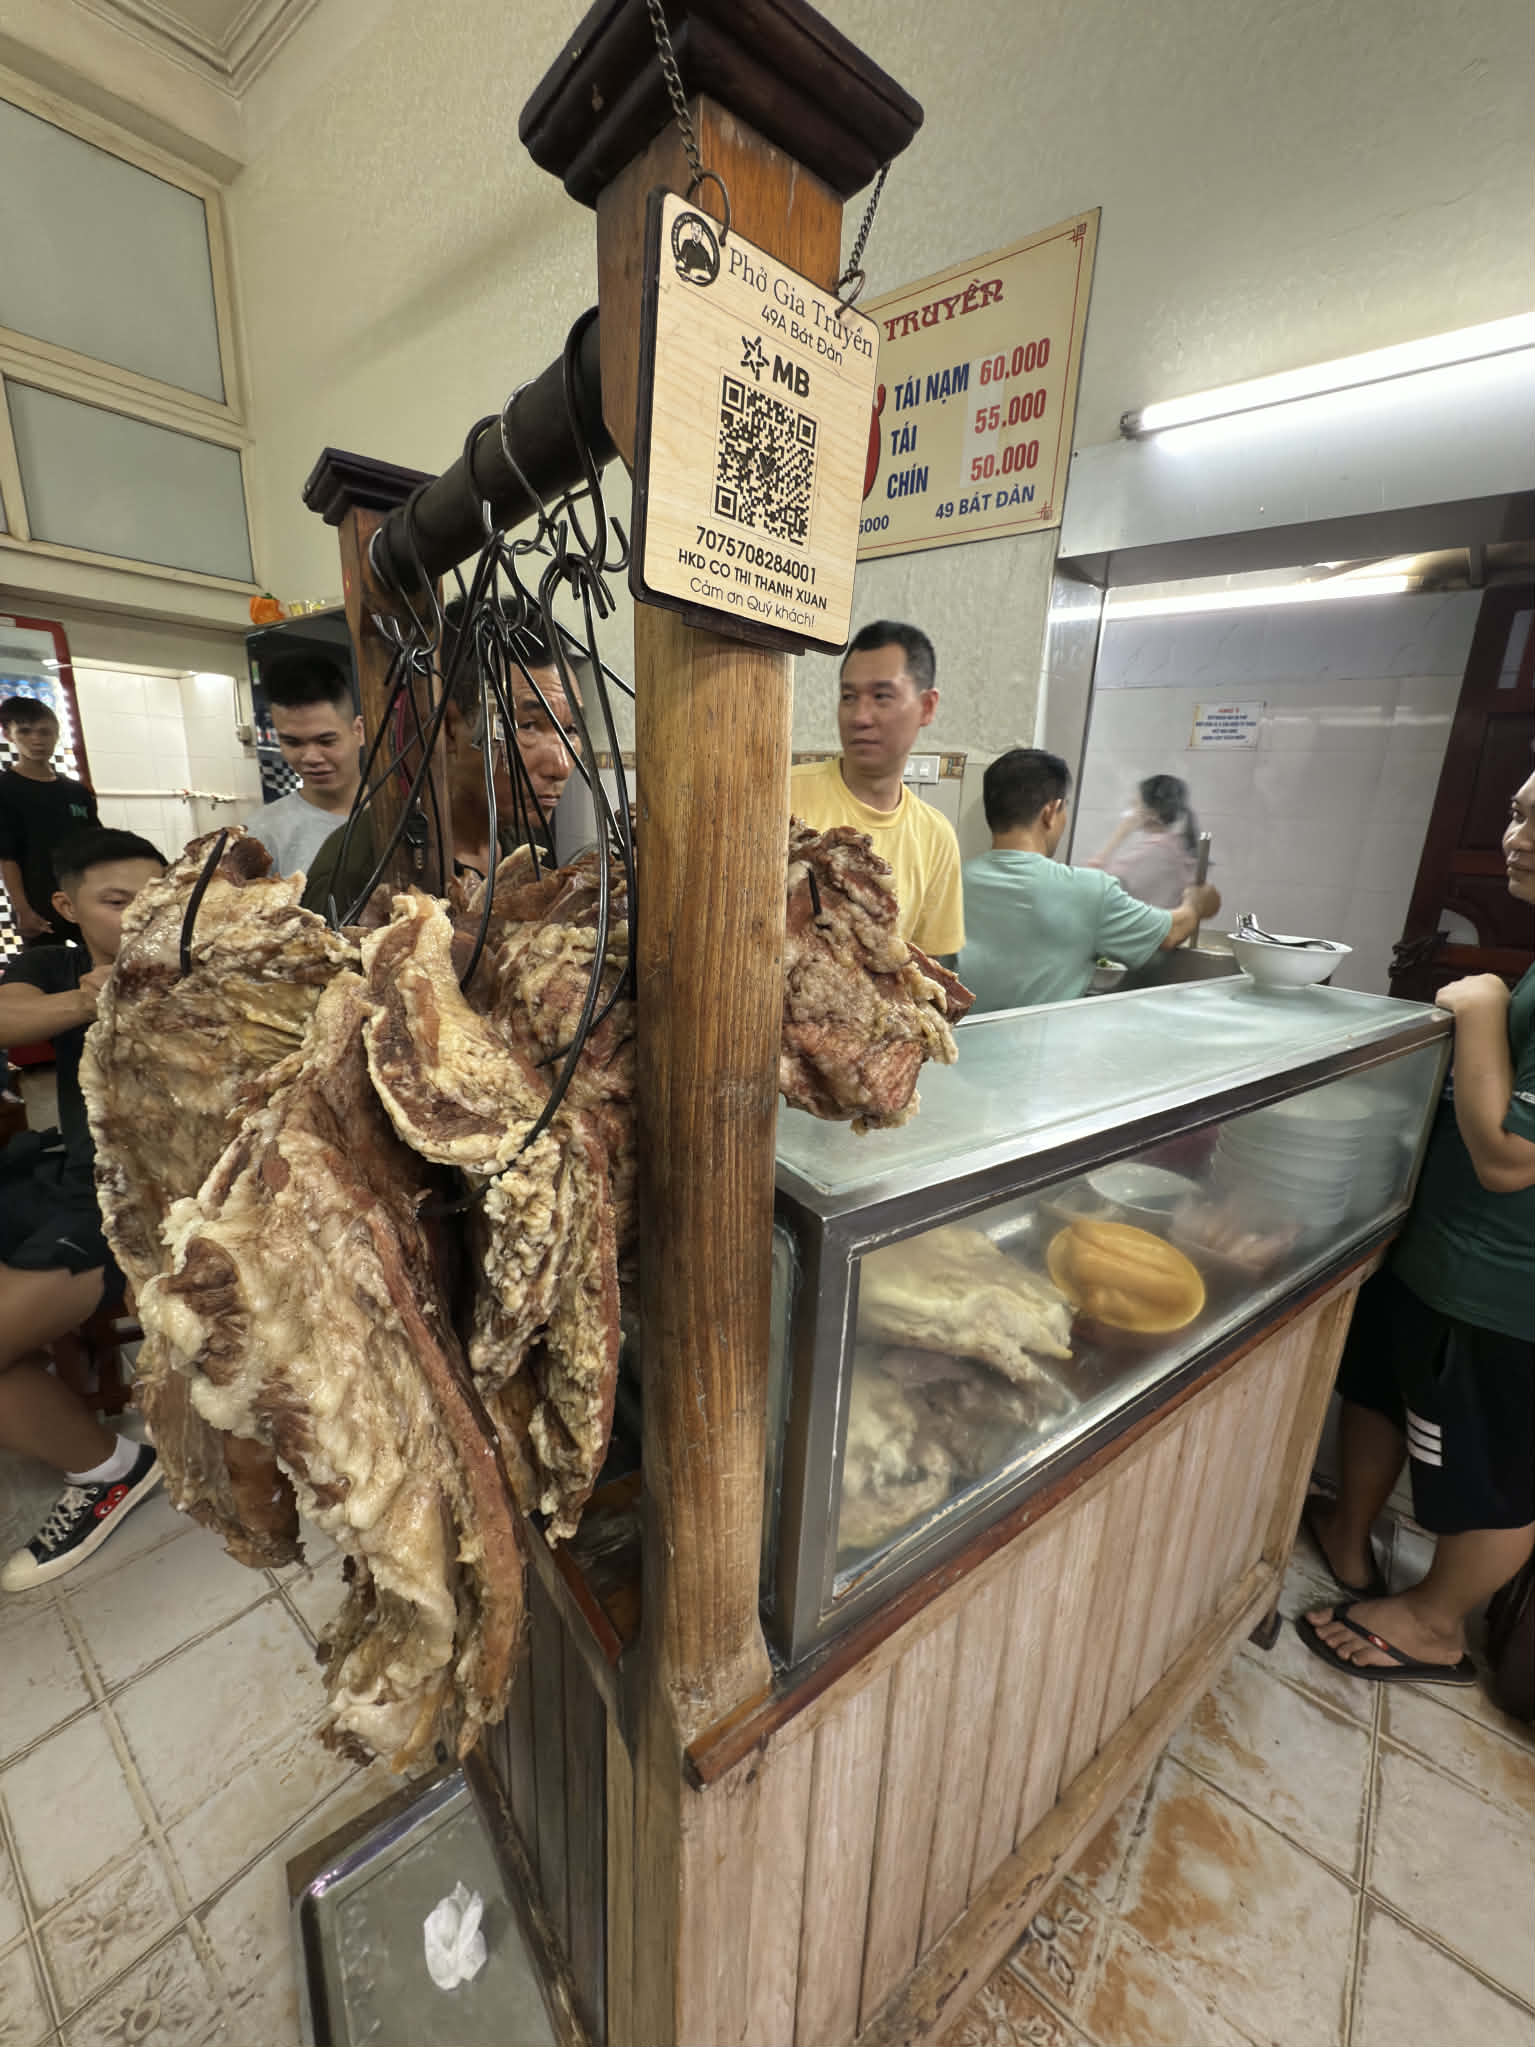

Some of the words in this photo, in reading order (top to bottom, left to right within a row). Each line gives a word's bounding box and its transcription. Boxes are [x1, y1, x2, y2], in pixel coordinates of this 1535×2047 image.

[728, 247, 768, 293] Phở
[773, 278, 806, 318] Gia
[883, 278, 1004, 341] TRUYỀN
[761, 305, 787, 334] 49A
[772, 354, 810, 398] MB
[894, 374, 921, 412] TÁI
[926, 362, 970, 405] NẠM
[979, 336, 1051, 386] 60.000
[890, 420, 918, 457] TÁI
[974, 387, 1047, 434] 55.000
[886, 464, 929, 500] CHÍN
[970, 438, 1040, 481] 50.000
[935, 502, 954, 519] 49
[959, 491, 992, 516] BÁT
[678, 548, 706, 570] HKD
[709, 559, 731, 578] CO
[734, 567, 752, 585] THI
[754, 574, 793, 599] THANH
[796, 588, 827, 610] XUAN
[696, 525, 816, 584] 7075708284001
[690, 577, 724, 601] Cảm
[747, 595, 772, 618] Quý
[775, 603, 815, 628] khách!
